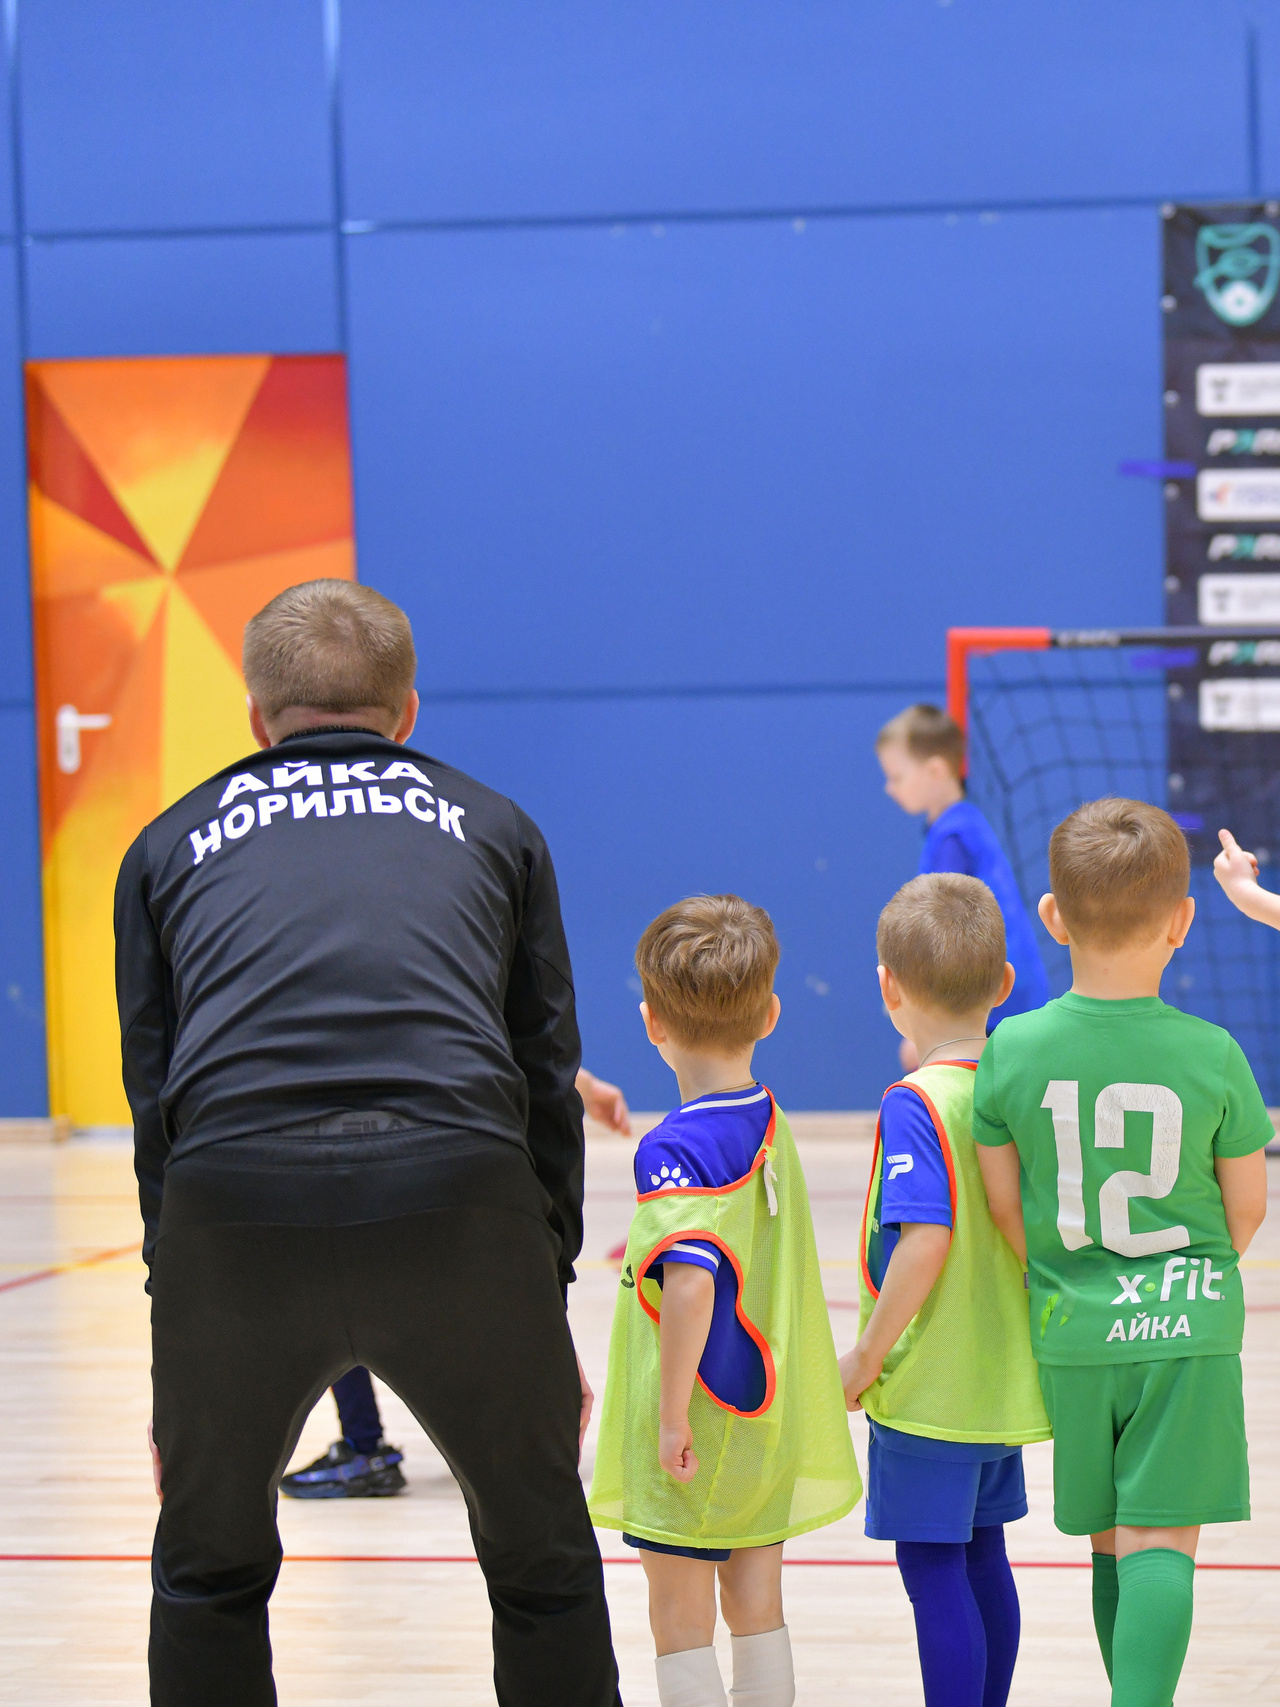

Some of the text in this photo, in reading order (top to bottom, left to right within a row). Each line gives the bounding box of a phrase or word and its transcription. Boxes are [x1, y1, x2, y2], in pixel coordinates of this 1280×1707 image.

[218, 761, 434, 808] АЙКА
[189, 786, 466, 865] НОРИЛЬСК
[1040, 1080, 1191, 1258] 12
[1105, 1312, 1191, 1342] АЙКА
